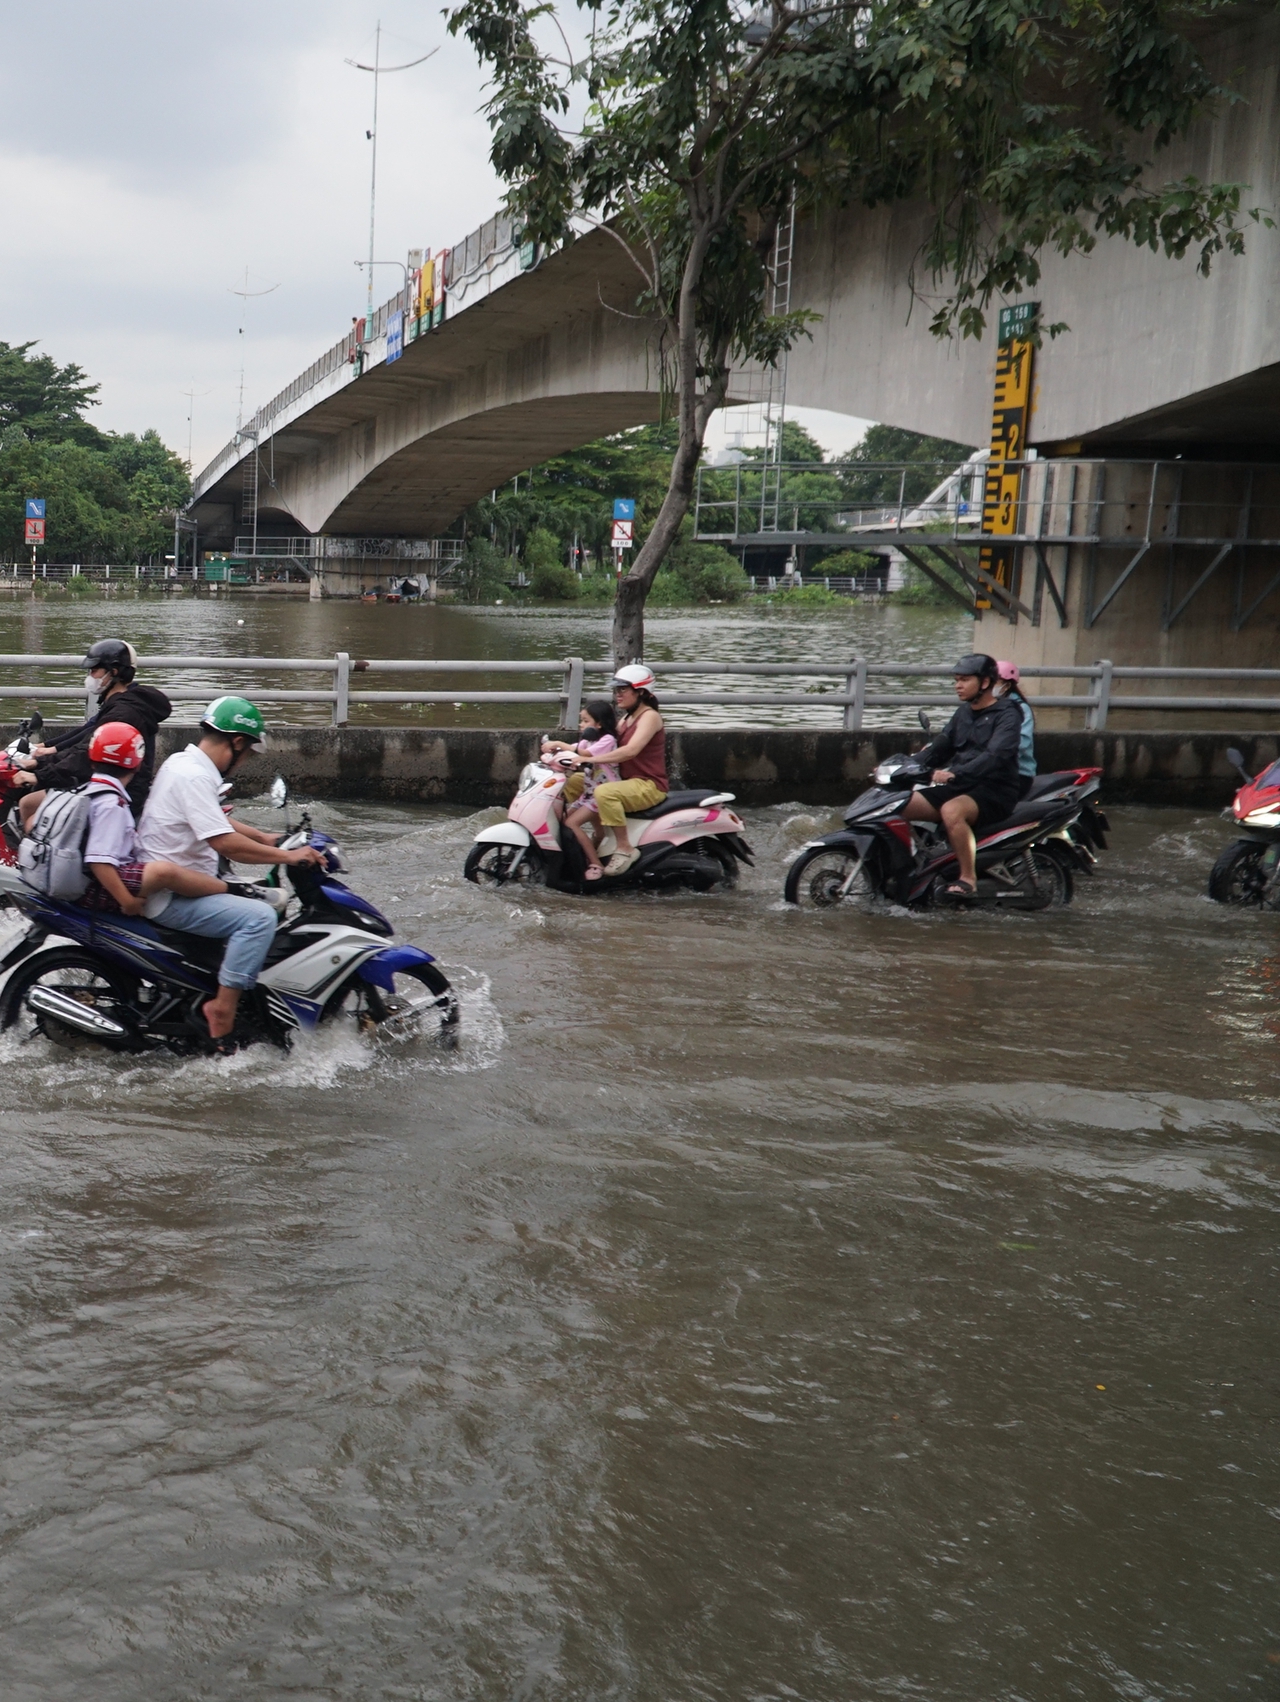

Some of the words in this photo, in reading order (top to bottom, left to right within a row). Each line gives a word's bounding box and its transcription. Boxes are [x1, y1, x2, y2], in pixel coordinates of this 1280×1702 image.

[1007, 424, 1020, 460] 2
[1001, 491, 1012, 526] 3
[233, 713, 258, 729] Grab
